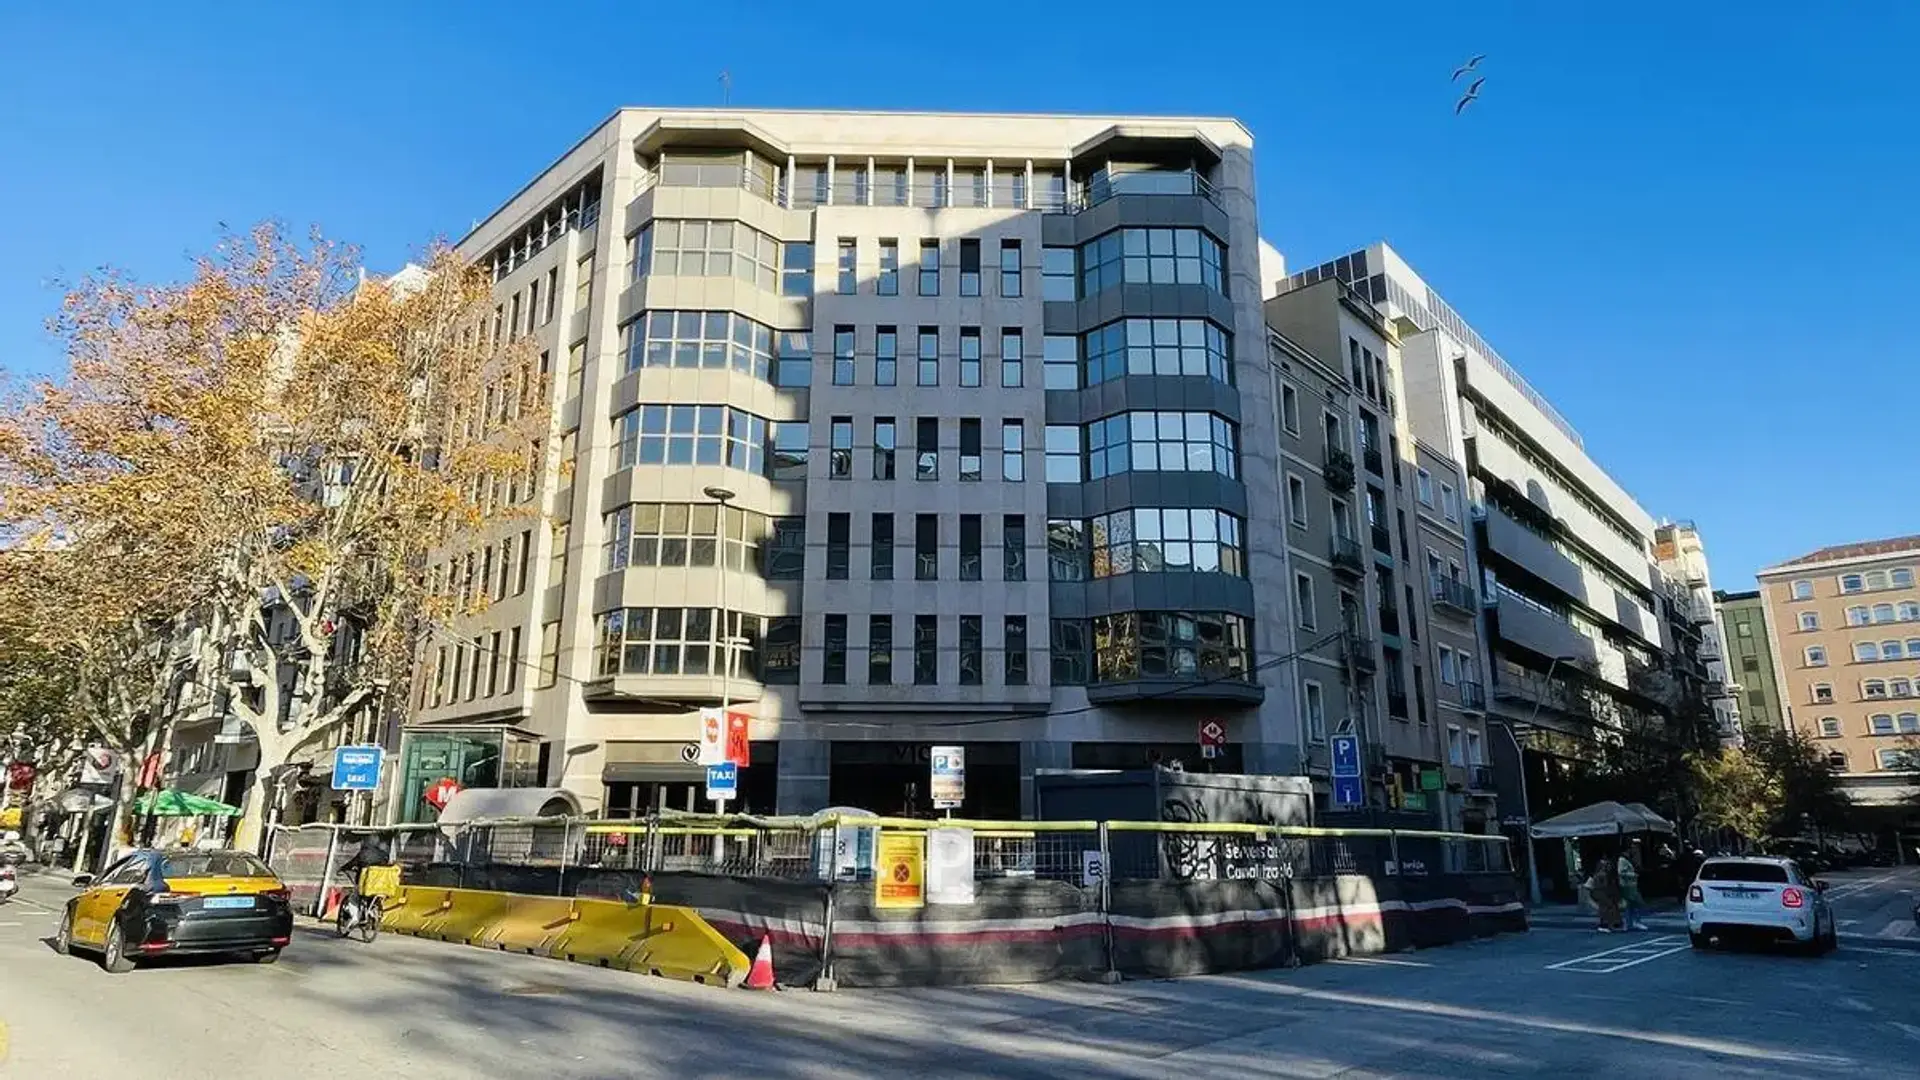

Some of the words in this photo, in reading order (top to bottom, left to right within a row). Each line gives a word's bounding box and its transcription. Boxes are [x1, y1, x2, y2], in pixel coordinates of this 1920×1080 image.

[1338, 740, 1350, 755] P
[936, 756, 946, 769] P
[710, 771, 735, 780] TAXI
[437, 785, 457, 803] M
